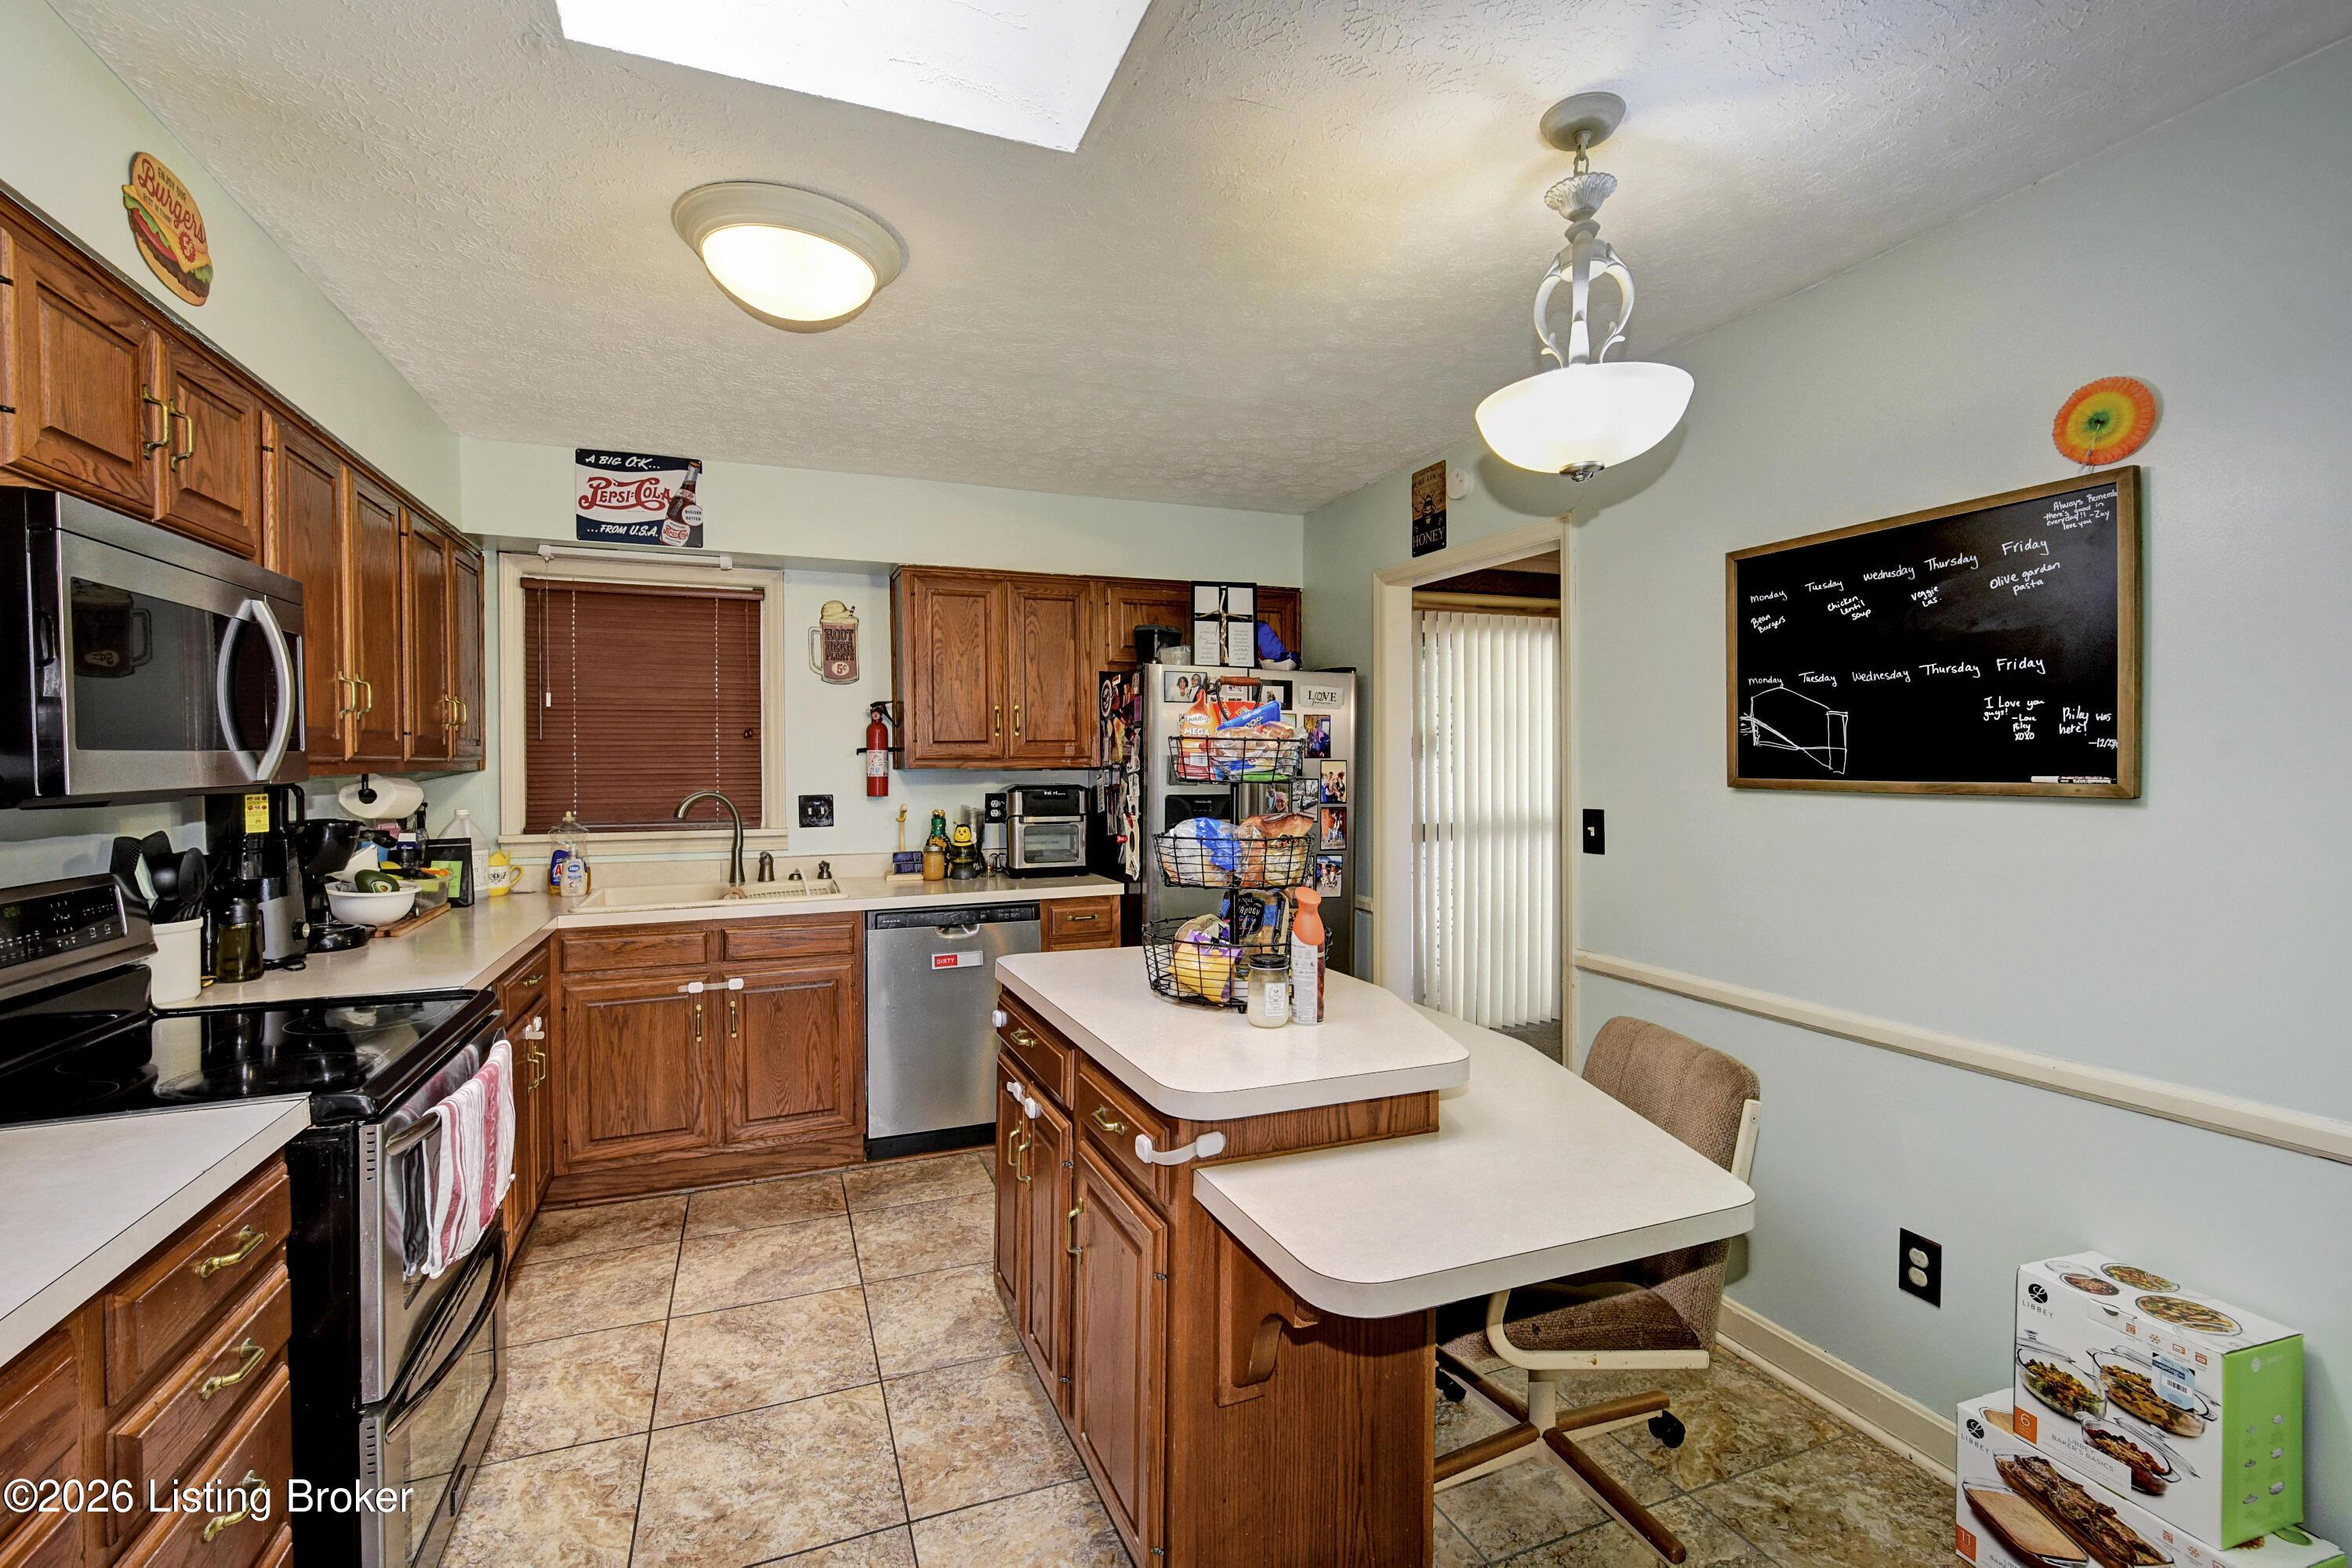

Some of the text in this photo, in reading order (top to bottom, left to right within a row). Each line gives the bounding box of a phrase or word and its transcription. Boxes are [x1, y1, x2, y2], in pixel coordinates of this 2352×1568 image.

[158, 166, 187, 203] ENJOY OUR
[138, 158, 206, 244] Burgers
[599, 456, 622, 465] BIG
[2054, 489, 2118, 511] Always Rememb
[2074, 505, 2091, 514] good
[630, 526, 659, 537] U.S.A.
[2078, 519, 2092, 528] you
[1413, 527, 1444, 548] HONEY
[1805, 579, 1844, 592] Tuesday
[1924, 553, 1979, 571] Thursday
[2002, 538, 2049, 556] Friday
[1990, 561, 2061, 589] Olive garden
[2013, 578, 2044, 595] pasta
[1751, 615, 1771, 629] Bean
[1852, 608, 1871, 620] soup
[1758, 615, 1786, 633] Burgers
[824, 628, 854, 641] ROOT
[825, 641, 854, 652] BEER
[825, 652, 855, 661] FLOATS
[837, 664, 848, 674] 5¢
[1798, 671, 1838, 688] Tuesday
[1852, 670, 1911, 683] Wednesday
[1919, 662, 1980, 678] Thursday
[1996, 657, 2046, 675] Friday
[1308, 691, 1337, 702] LOVE
[1984, 696, 1994, 709] I
[2027, 699, 2045, 710] you
[2063, 706, 2112, 722] Riley was
[2022, 1300, 2054, 1318] LIBBEY
[2020, 1414, 2031, 1427] 6
[1961, 1433, 1989, 1453] LIBBEY
[2052, 1435, 2083, 1456] BAKER'S
[2085, 1453, 2114, 1472] BASICS
[1961, 1530, 1971, 1546] 11
